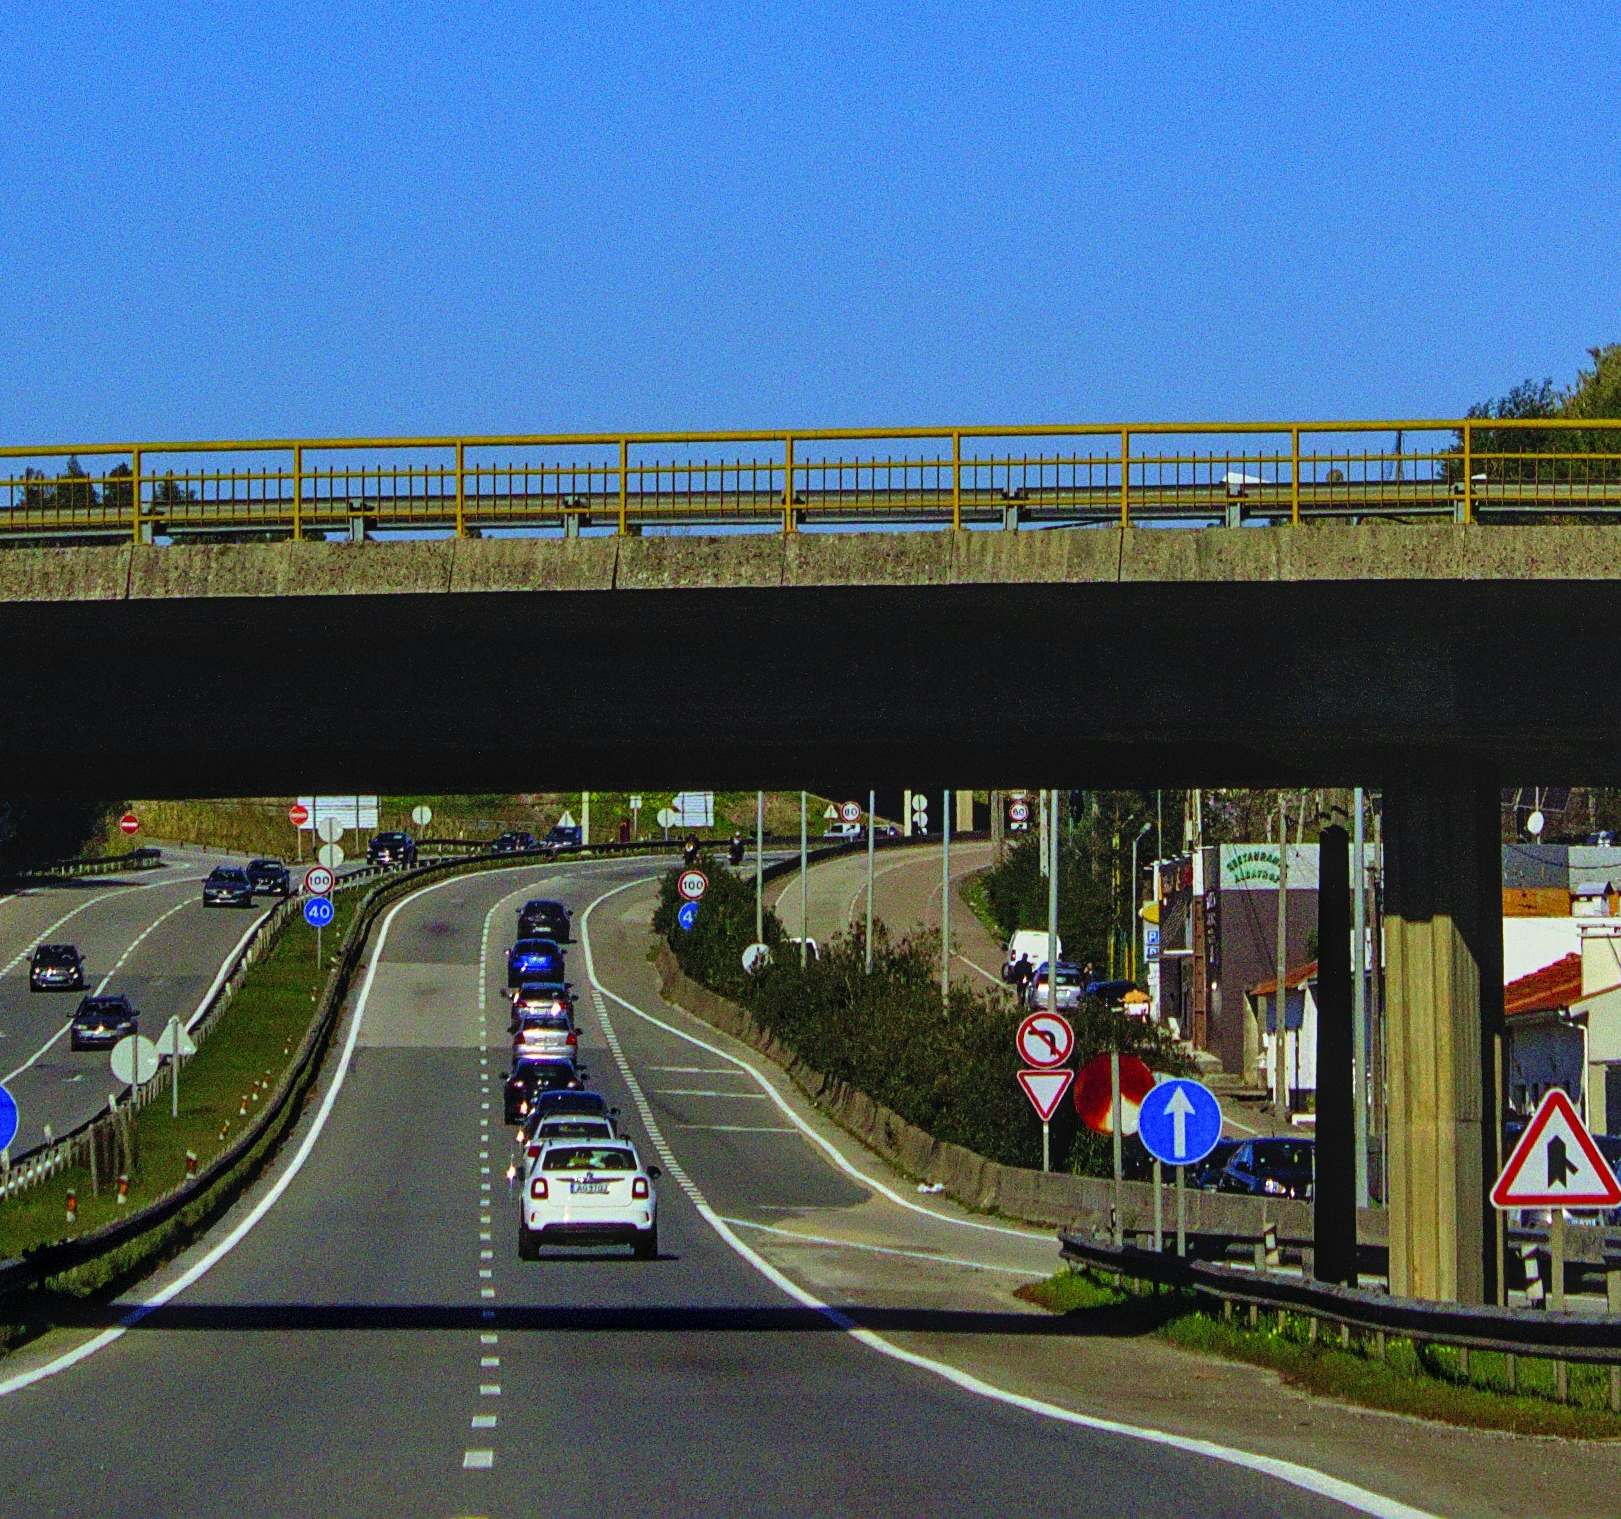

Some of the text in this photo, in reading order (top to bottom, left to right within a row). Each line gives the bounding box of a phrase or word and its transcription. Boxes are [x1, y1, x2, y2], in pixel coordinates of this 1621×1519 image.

[309, 876, 330, 886] 100
[683, 880, 704, 890] 100
[308, 904, 330, 919] 40
